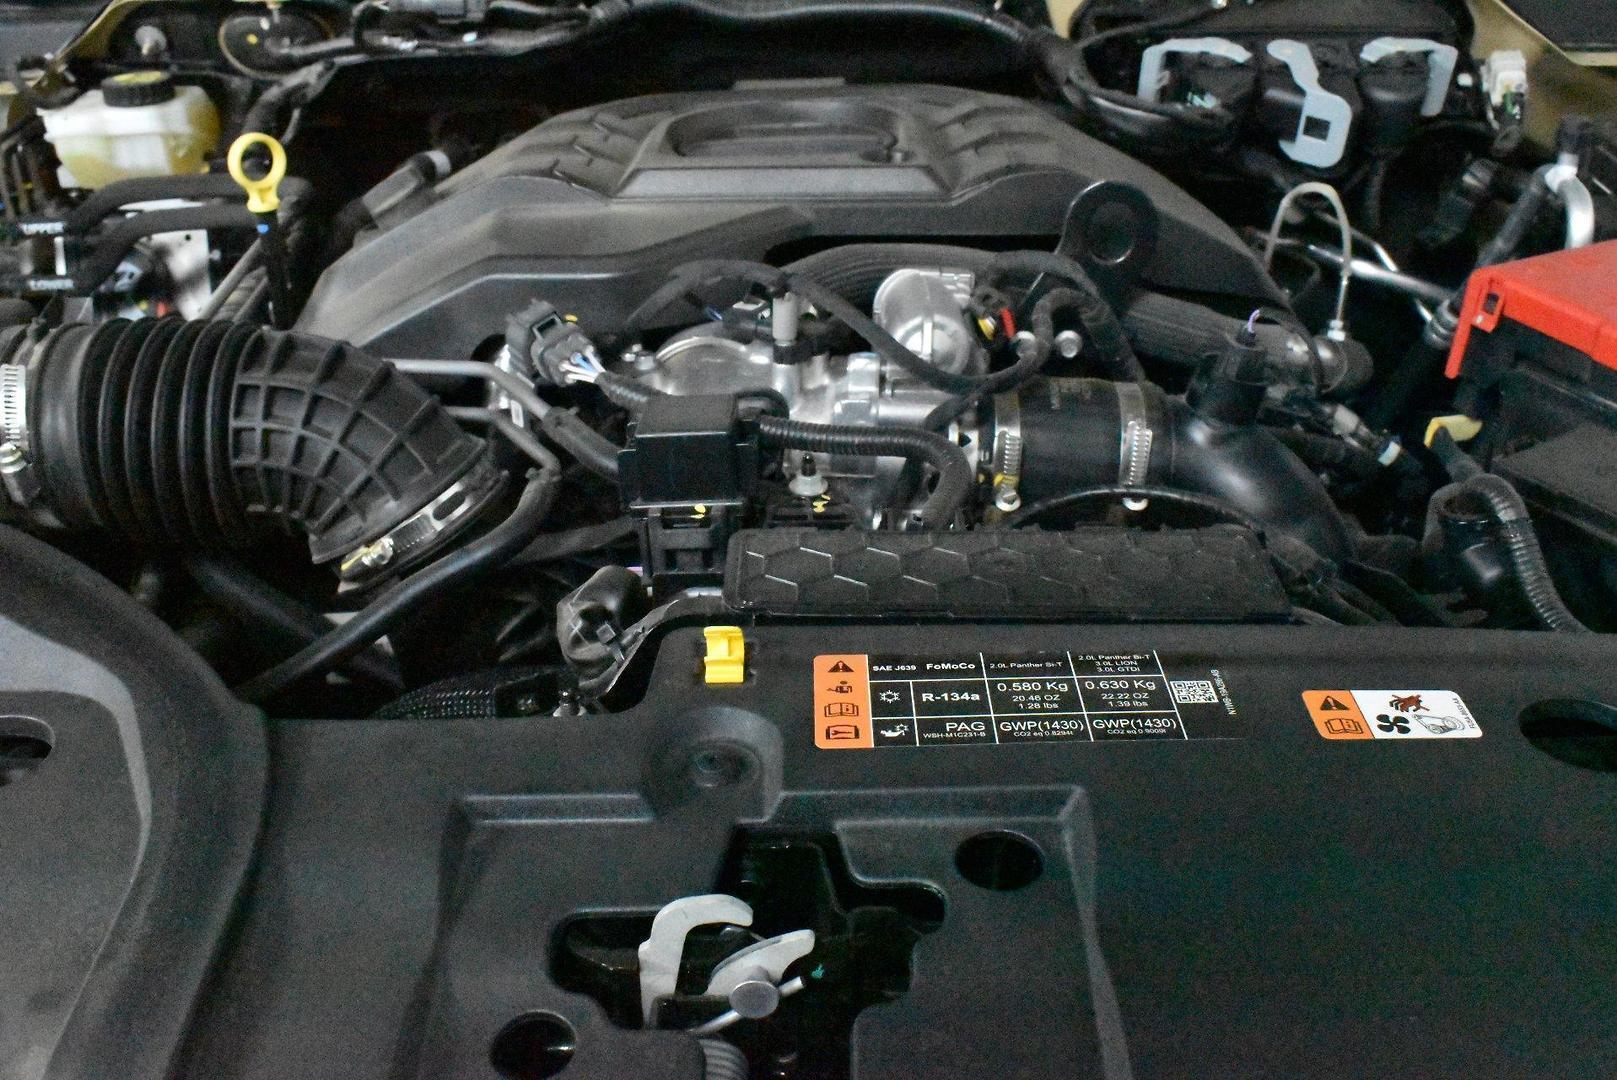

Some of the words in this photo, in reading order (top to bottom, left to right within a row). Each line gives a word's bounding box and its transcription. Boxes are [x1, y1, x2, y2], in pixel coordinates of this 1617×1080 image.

[997, 682, 1041, 692] 0.580
[1046, 681, 1069, 692] Kg
[1085, 680, 1129, 690] 0.630
[1133, 680, 1156, 691] Kg
[922, 692, 980, 702] R-134a
[945, 722, 986, 732] PAG
[1000, 720, 1083, 732] GWP(1430)
[1093, 718, 1177, 730] GWP(1430)
